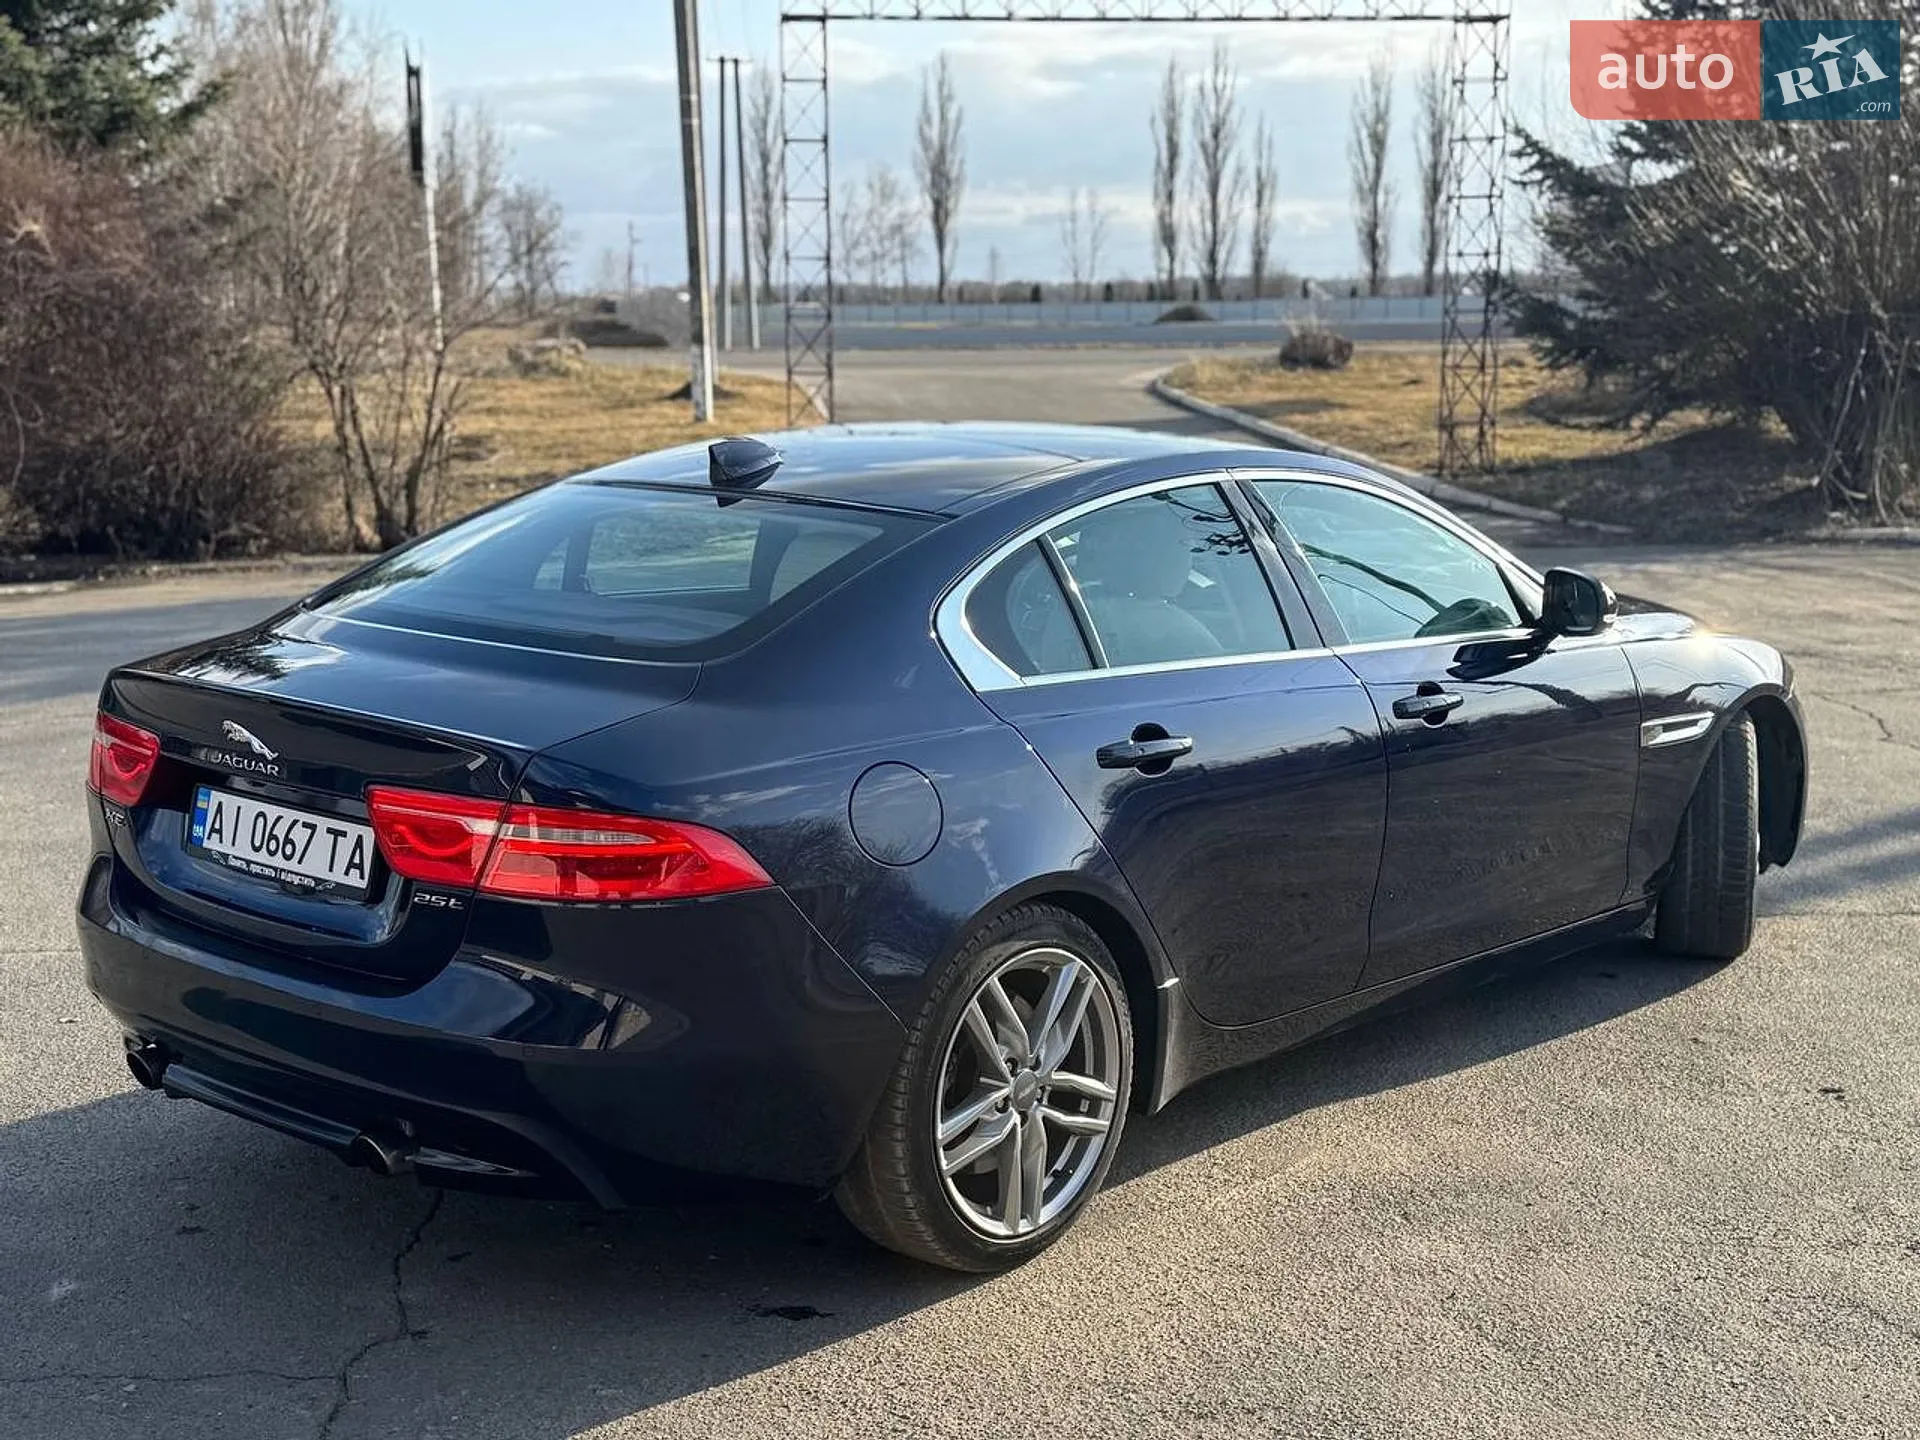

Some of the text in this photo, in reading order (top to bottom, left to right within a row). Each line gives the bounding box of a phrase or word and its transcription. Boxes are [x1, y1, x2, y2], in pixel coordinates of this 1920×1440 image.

[211, 752, 280, 777] JAGUAR
[206, 800, 365, 881] AI 0667 TA
[412, 891, 465, 911] 25t
